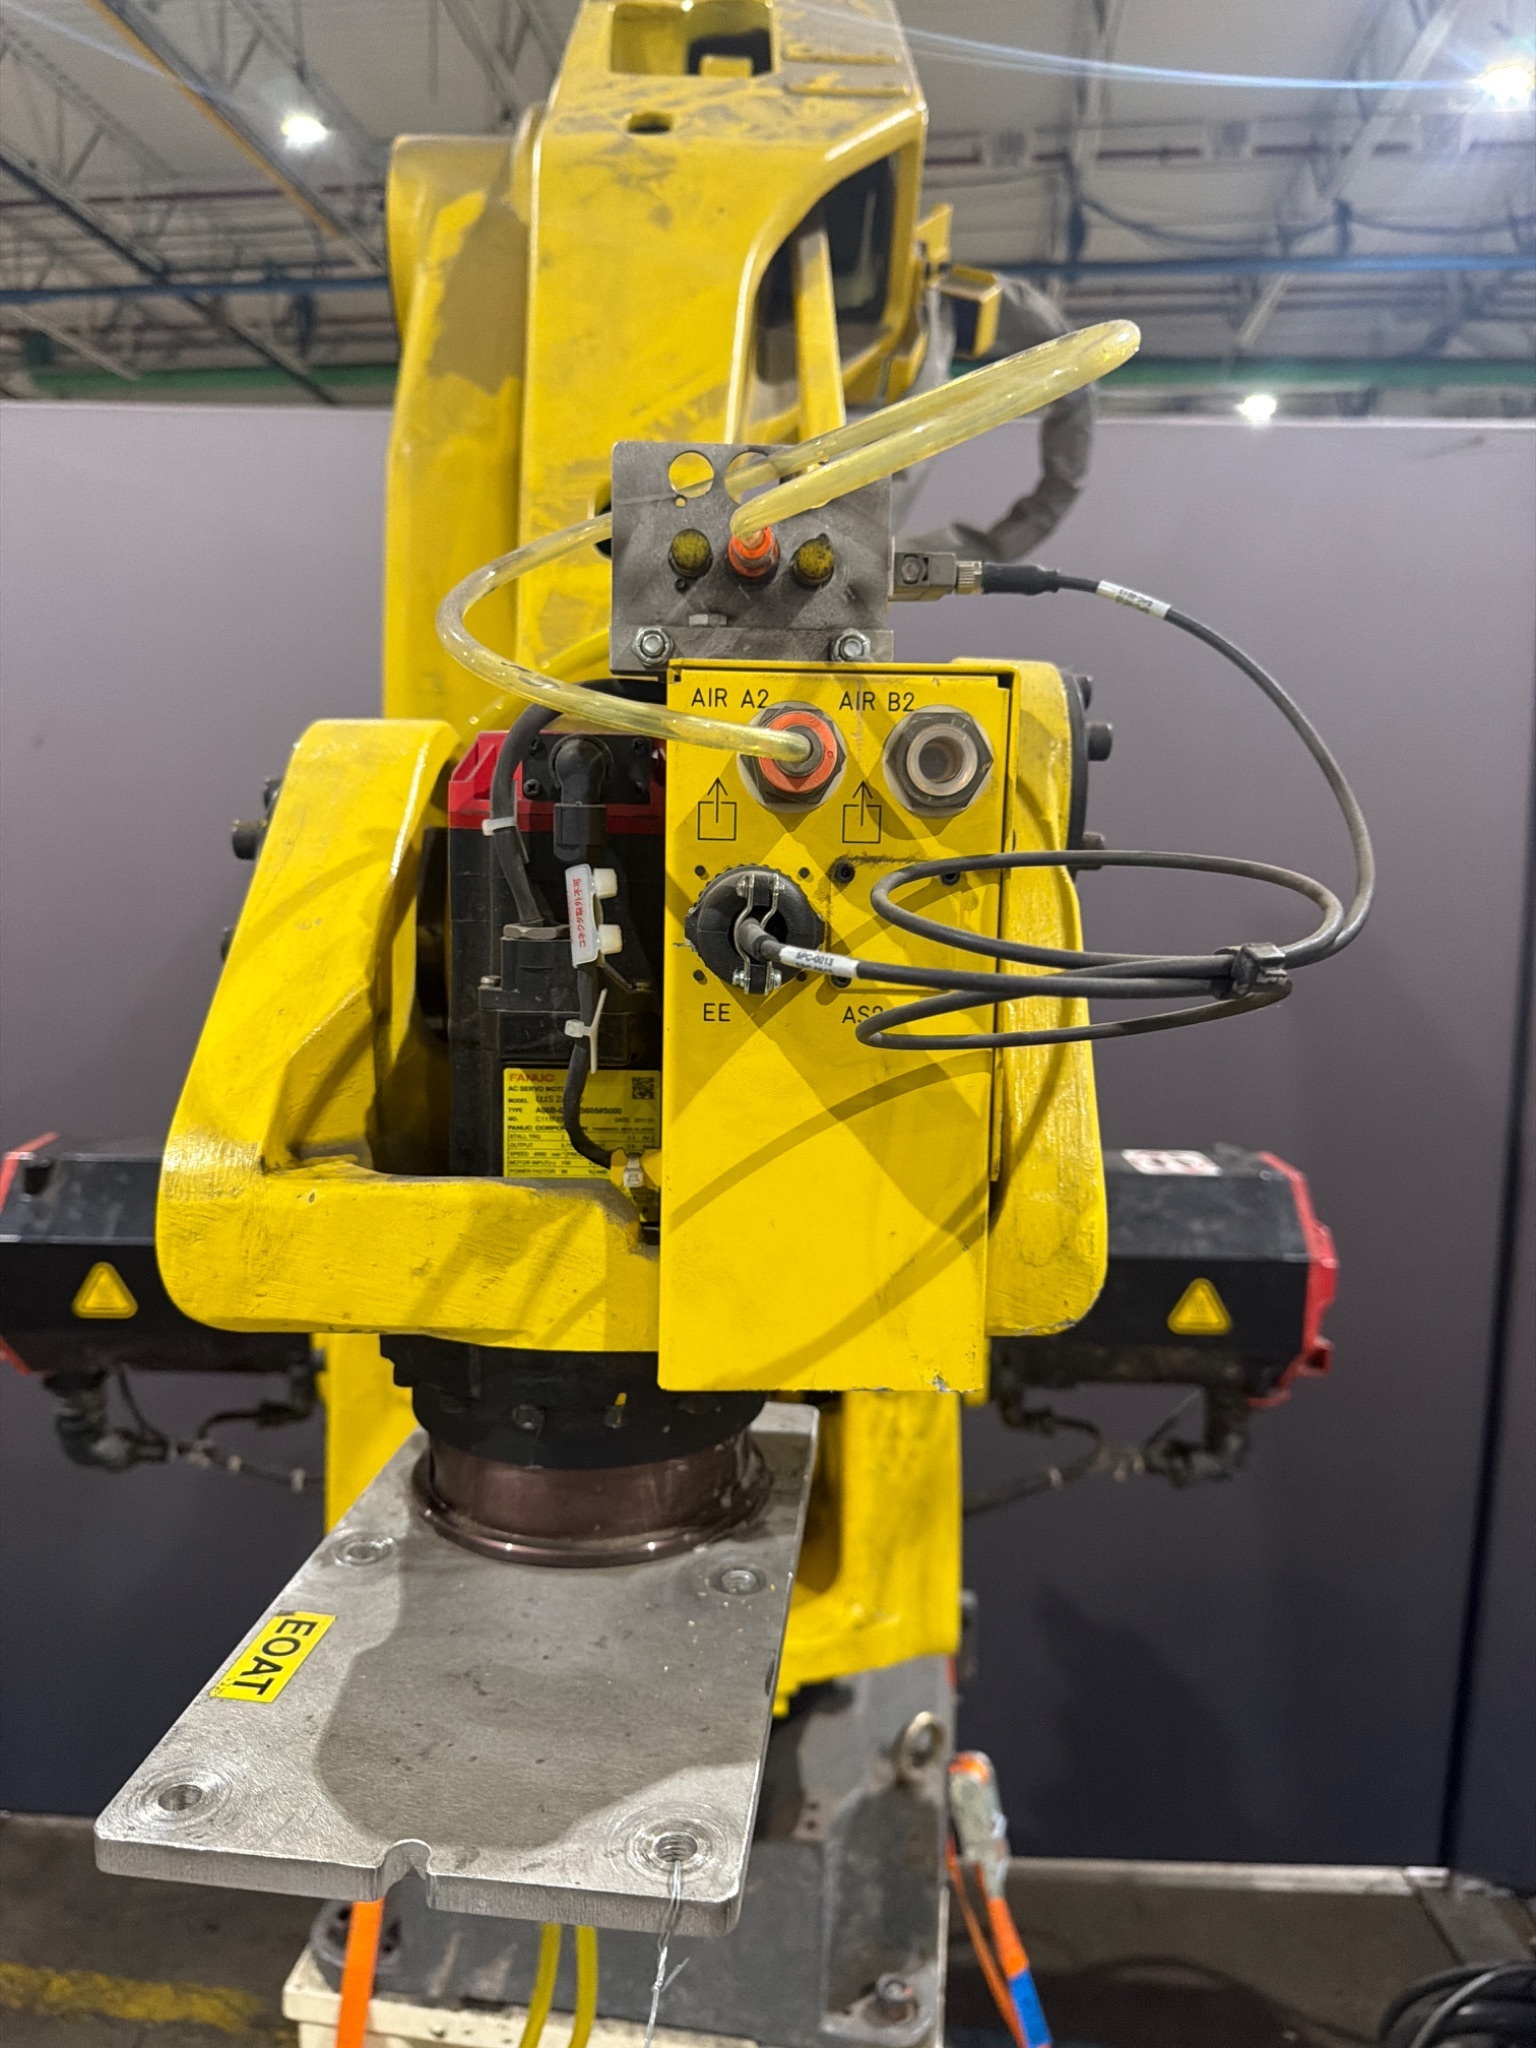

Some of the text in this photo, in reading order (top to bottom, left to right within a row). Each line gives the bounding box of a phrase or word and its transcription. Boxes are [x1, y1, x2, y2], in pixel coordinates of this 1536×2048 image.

[691, 687, 770, 709] AIR A2
[838, 691, 915, 712] AIR B2
[703, 1002, 731, 1022] EE
[508, 1073, 555, 1083] FANUC
[232, 1619, 319, 1696] EOAT
